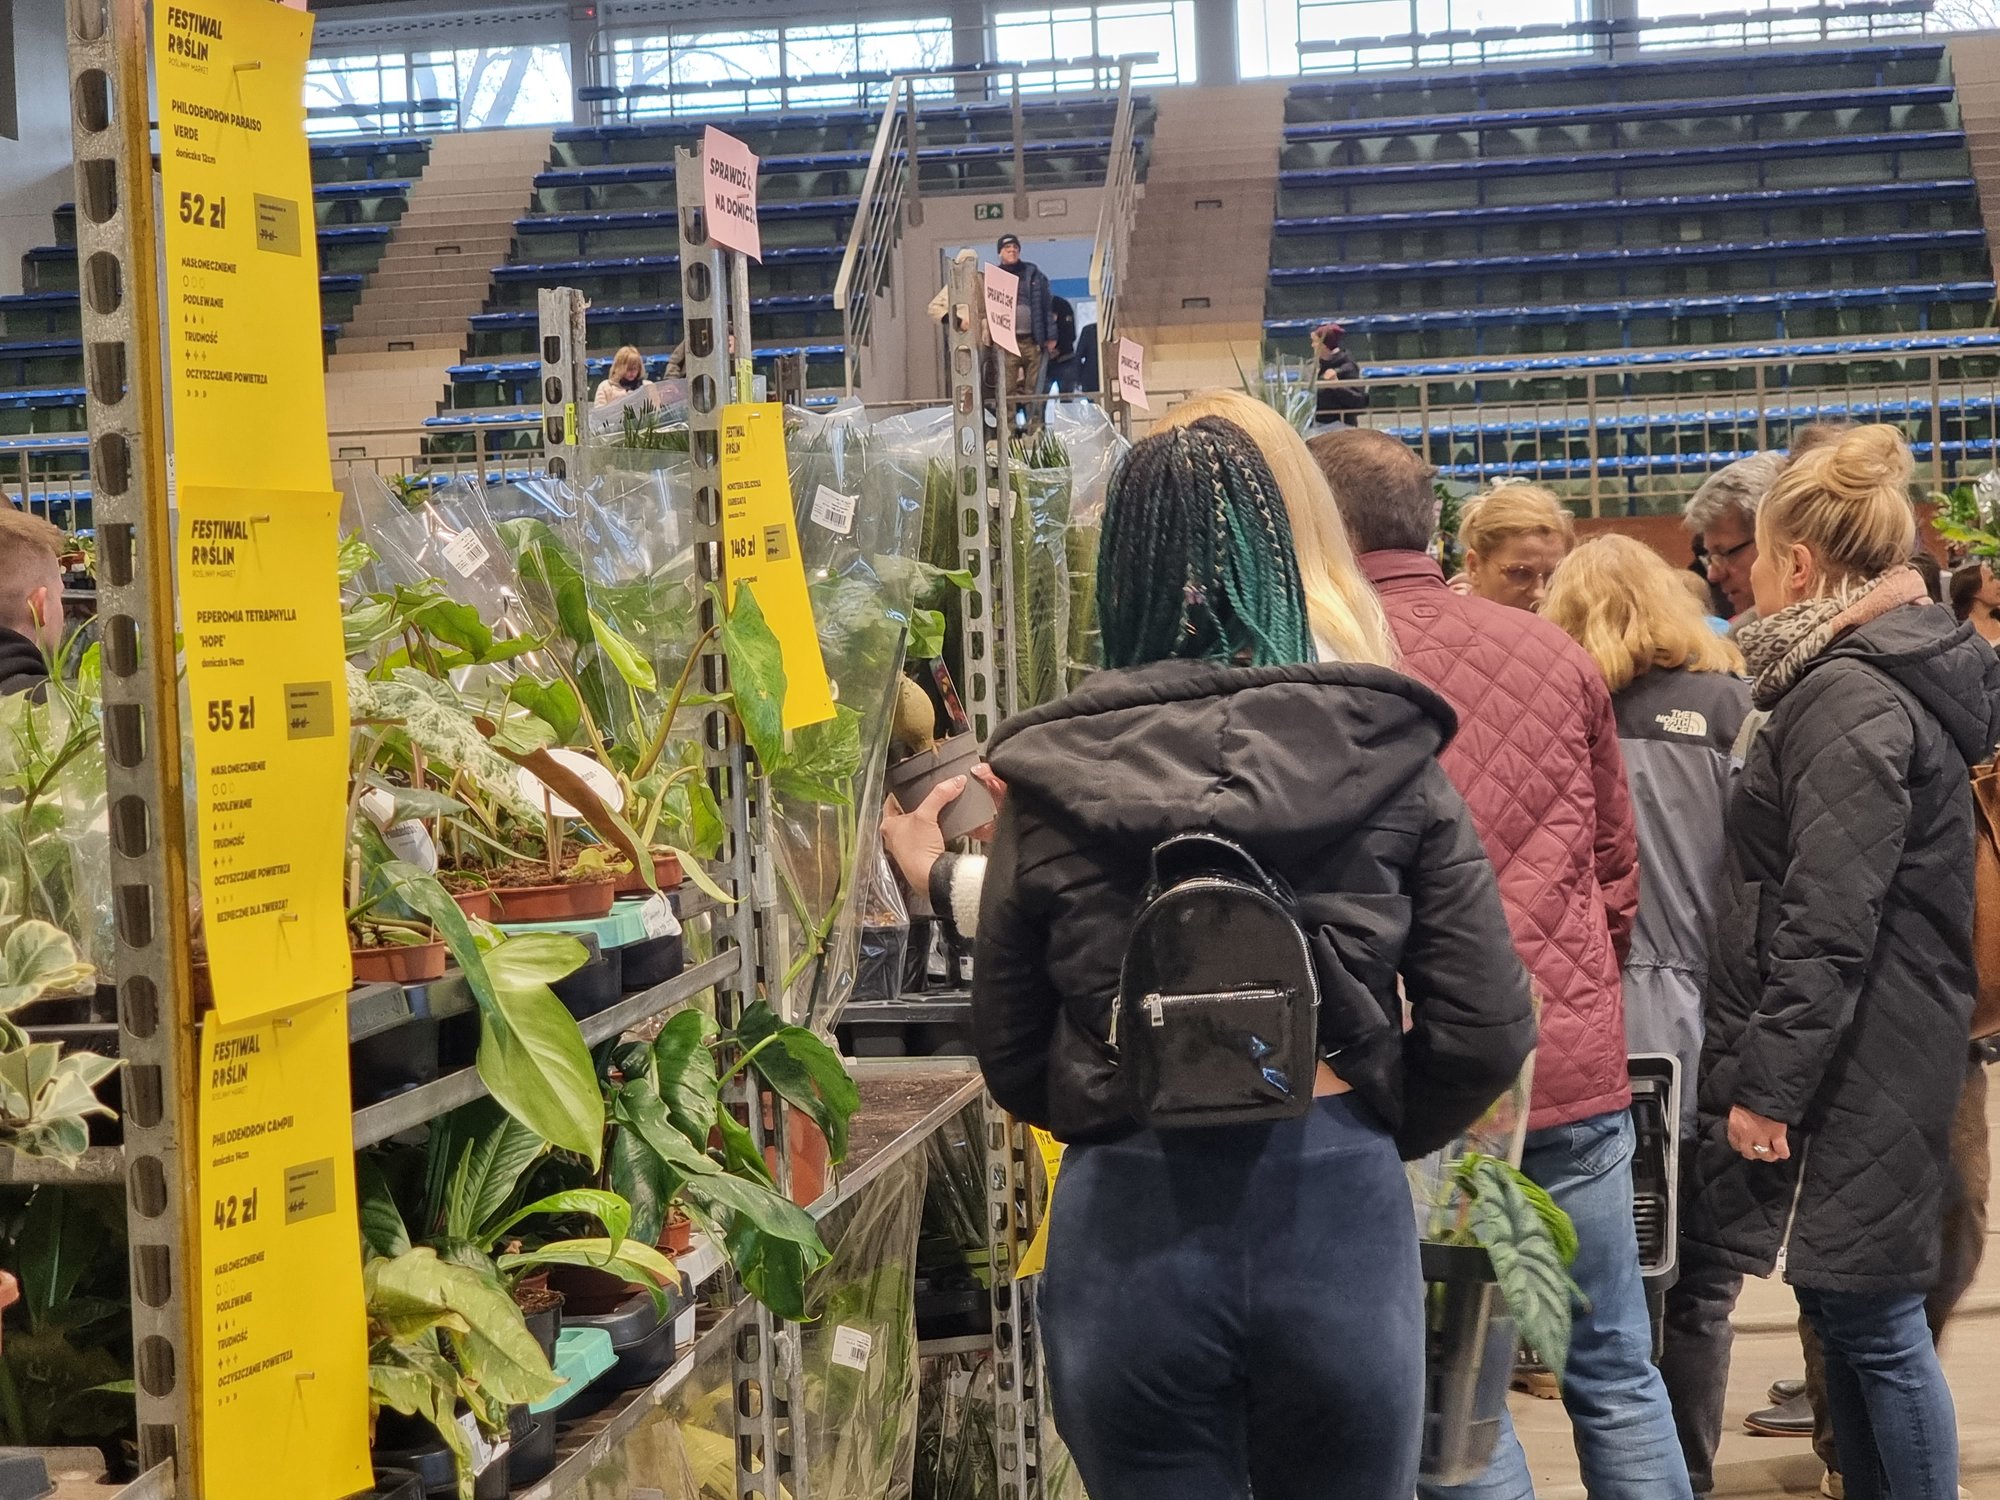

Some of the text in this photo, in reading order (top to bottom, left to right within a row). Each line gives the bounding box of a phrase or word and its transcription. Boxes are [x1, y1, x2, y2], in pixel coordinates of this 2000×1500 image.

[168, 6, 222, 40] FESTIWAL
[171, 99, 262, 132] PHILODENDRON PARAISO
[173, 123, 199, 141] VERDE
[176, 147, 216, 165] doniczka 12cm
[709, 157, 746, 189] SPRAWDŹ
[180, 191, 205, 226] 52
[714, 193, 725, 212] NA
[182, 256, 236, 274] NASŁONECZNIENIE
[183, 294, 224, 308] PODLEWANIE
[185, 330, 218, 344] TRUDNOŚĆ
[186, 368, 268, 384] OCZYSZCZANIE POWIETRZA
[192, 519, 248, 539] FESTIWAL
[731, 537, 746, 559] 148
[197, 609, 297, 623] PEPEROMIA TETRAPHYLLA
[202, 657, 244, 668] doniczka 14cm
[208, 699, 234, 732] 55
[1655, 714, 1689, 727] NORTH
[1670, 709, 1690, 719] THE
[1663, 724, 1689, 734] FACE
[211, 760, 266, 776] NASŁONECZNIENIE
[212, 798, 252, 812] PODLEWANIE
[213, 833, 245, 849] TRUDNOŚĆ
[214, 864, 290, 886] OCZYSZCZANIE POWIETRZA
[217, 906, 249, 923] BEZPIECZNE
[250, 904, 260, 916] DLA
[213, 1034, 260, 1062] FESTIWAL
[212, 1121, 266, 1147] PHILODENDRON
[213, 1195, 237, 1231] 42
[214, 1251, 265, 1276] NASŁONECZNIENIE
[216, 1292, 252, 1313] PODLEWANIE
[217, 1327, 248, 1350] TRUDNOŚĆ
[218, 1349, 293, 1387] OCZYSZCZANIE POWIETRZA
